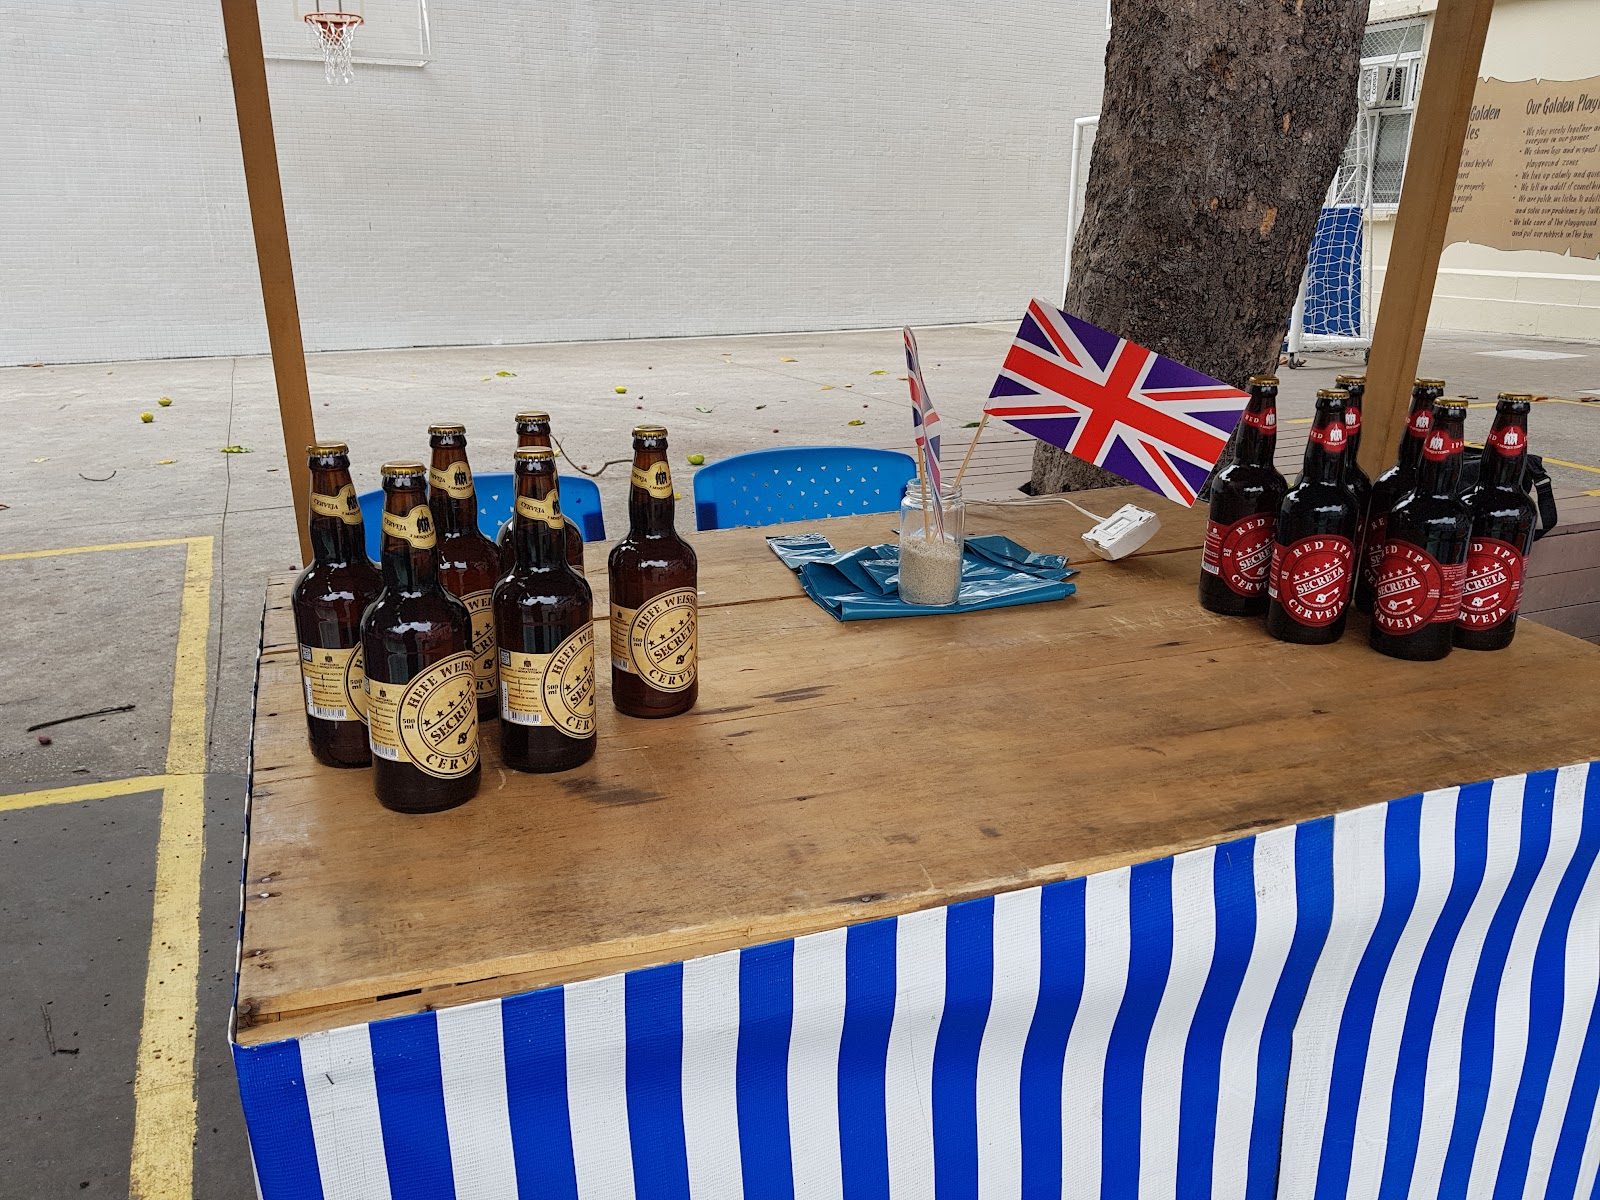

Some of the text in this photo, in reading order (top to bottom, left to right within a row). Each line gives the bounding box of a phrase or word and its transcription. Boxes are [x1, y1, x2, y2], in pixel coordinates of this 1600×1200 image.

[1469, 104, 1500, 121] Golden
[1526, 98, 1542, 115] Our
[1543, 97, 1575, 115] Golden
[1466, 124, 1480, 140] les
[1563, 146, 1575, 154] and
[1573, 170, 1586, 178] and
[1551, 206, 1578, 216] problems
[1564, 218, 1598, 228] playground
[1512, 229, 1523, 237] and
[1244, 414, 1259, 423] RED
[313, 498, 339, 510] CERVEJA
[521, 501, 545, 513] CERVEJA
[384, 517, 407, 531] CERVEJA
[1235, 518, 1265, 536] RED
[1239, 544, 1273, 570] SECRE
[1293, 541, 1324, 558] RED
[1333, 542, 1351, 560] IPA
[1493, 546, 1516, 566] IPA
[1406, 550, 1431, 572] IPA
[1231, 574, 1269, 591] CERVE
[1295, 566, 1344, 594] SECRETA
[1378, 576, 1420, 597] SECRETA
[467, 597, 491, 611] WEI
[637, 594, 696, 631] HEFE WEISS
[1288, 599, 1344, 620] CERVEJA
[1459, 607, 1507, 624] RVEJA
[653, 620, 695, 660] SECRETA
[551, 643, 578, 675] HEFE
[406, 675, 438, 709] HEFE
[570, 673, 594, 705] SECR
[426, 746, 478, 770] CERVE
